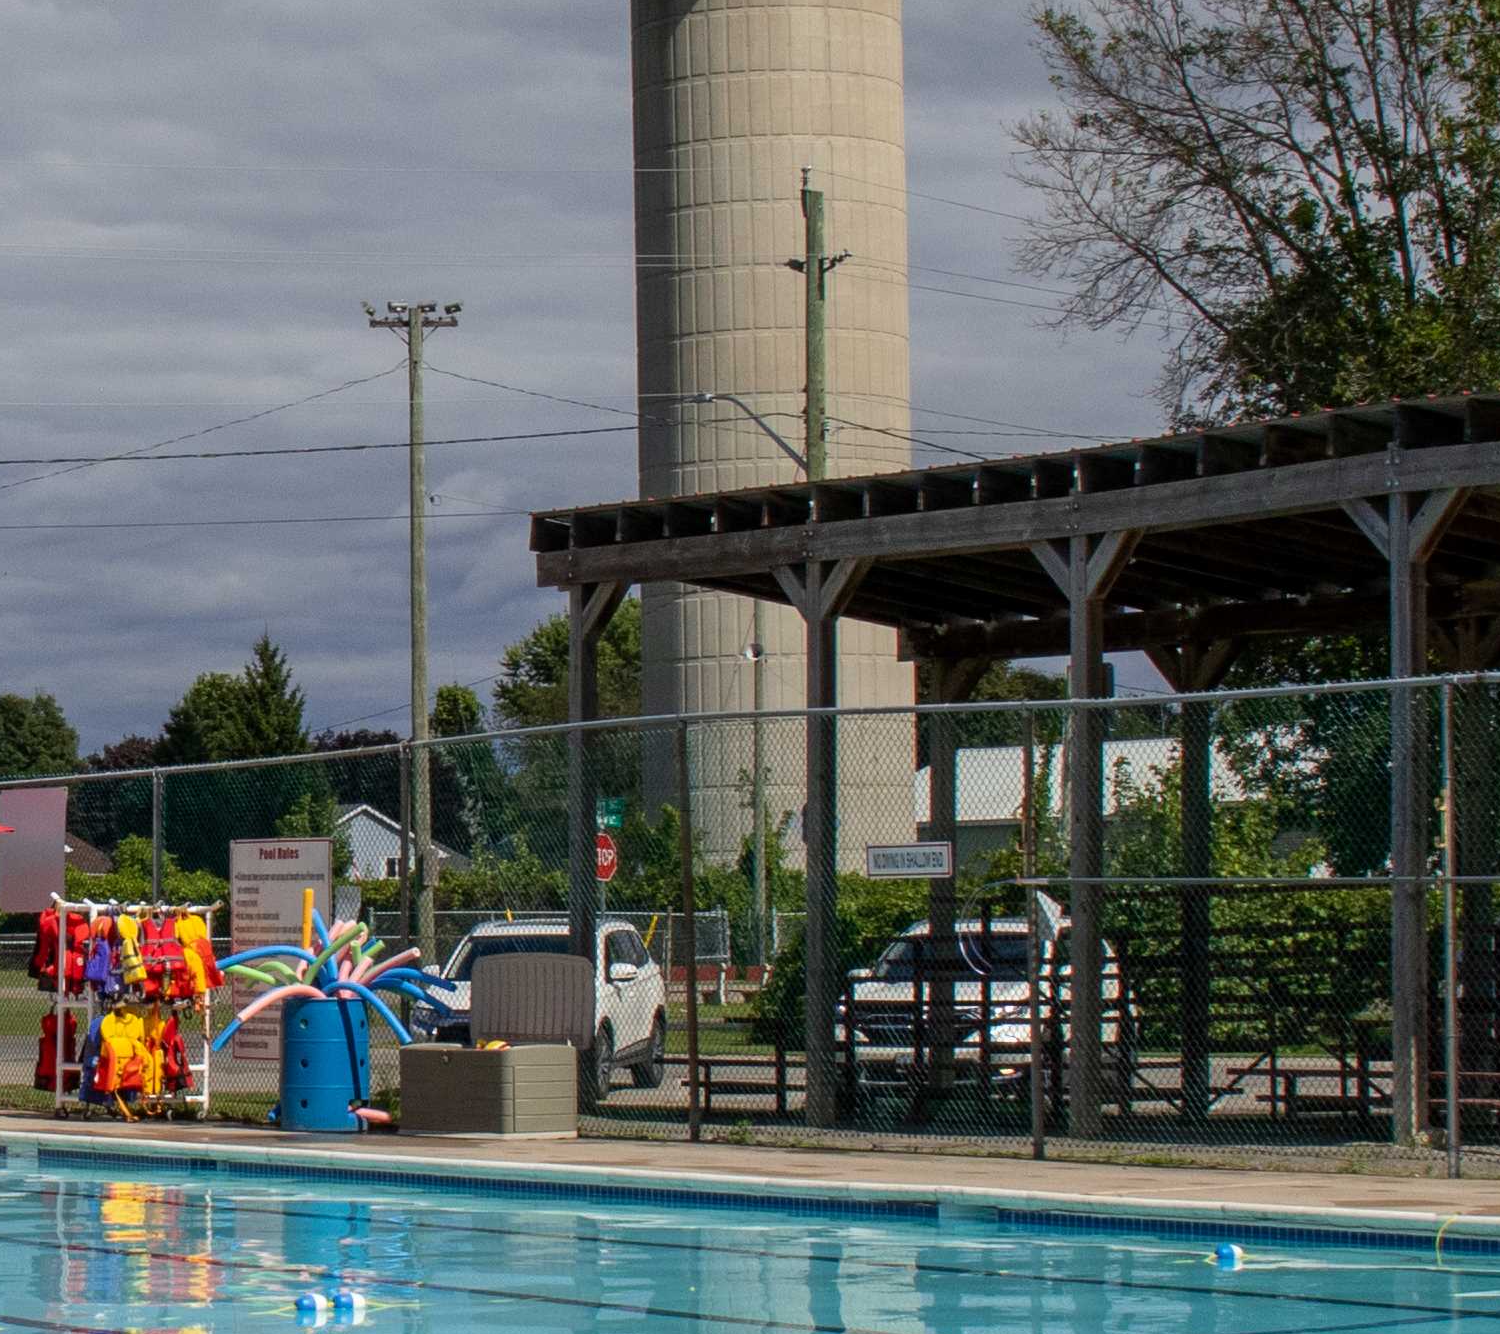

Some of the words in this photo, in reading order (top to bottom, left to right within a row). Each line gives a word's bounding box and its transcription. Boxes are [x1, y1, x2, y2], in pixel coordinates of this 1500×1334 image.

[259, 848, 276, 860] Pool
[278, 847, 299, 860] Rules
[596, 848, 614, 867] TOP
